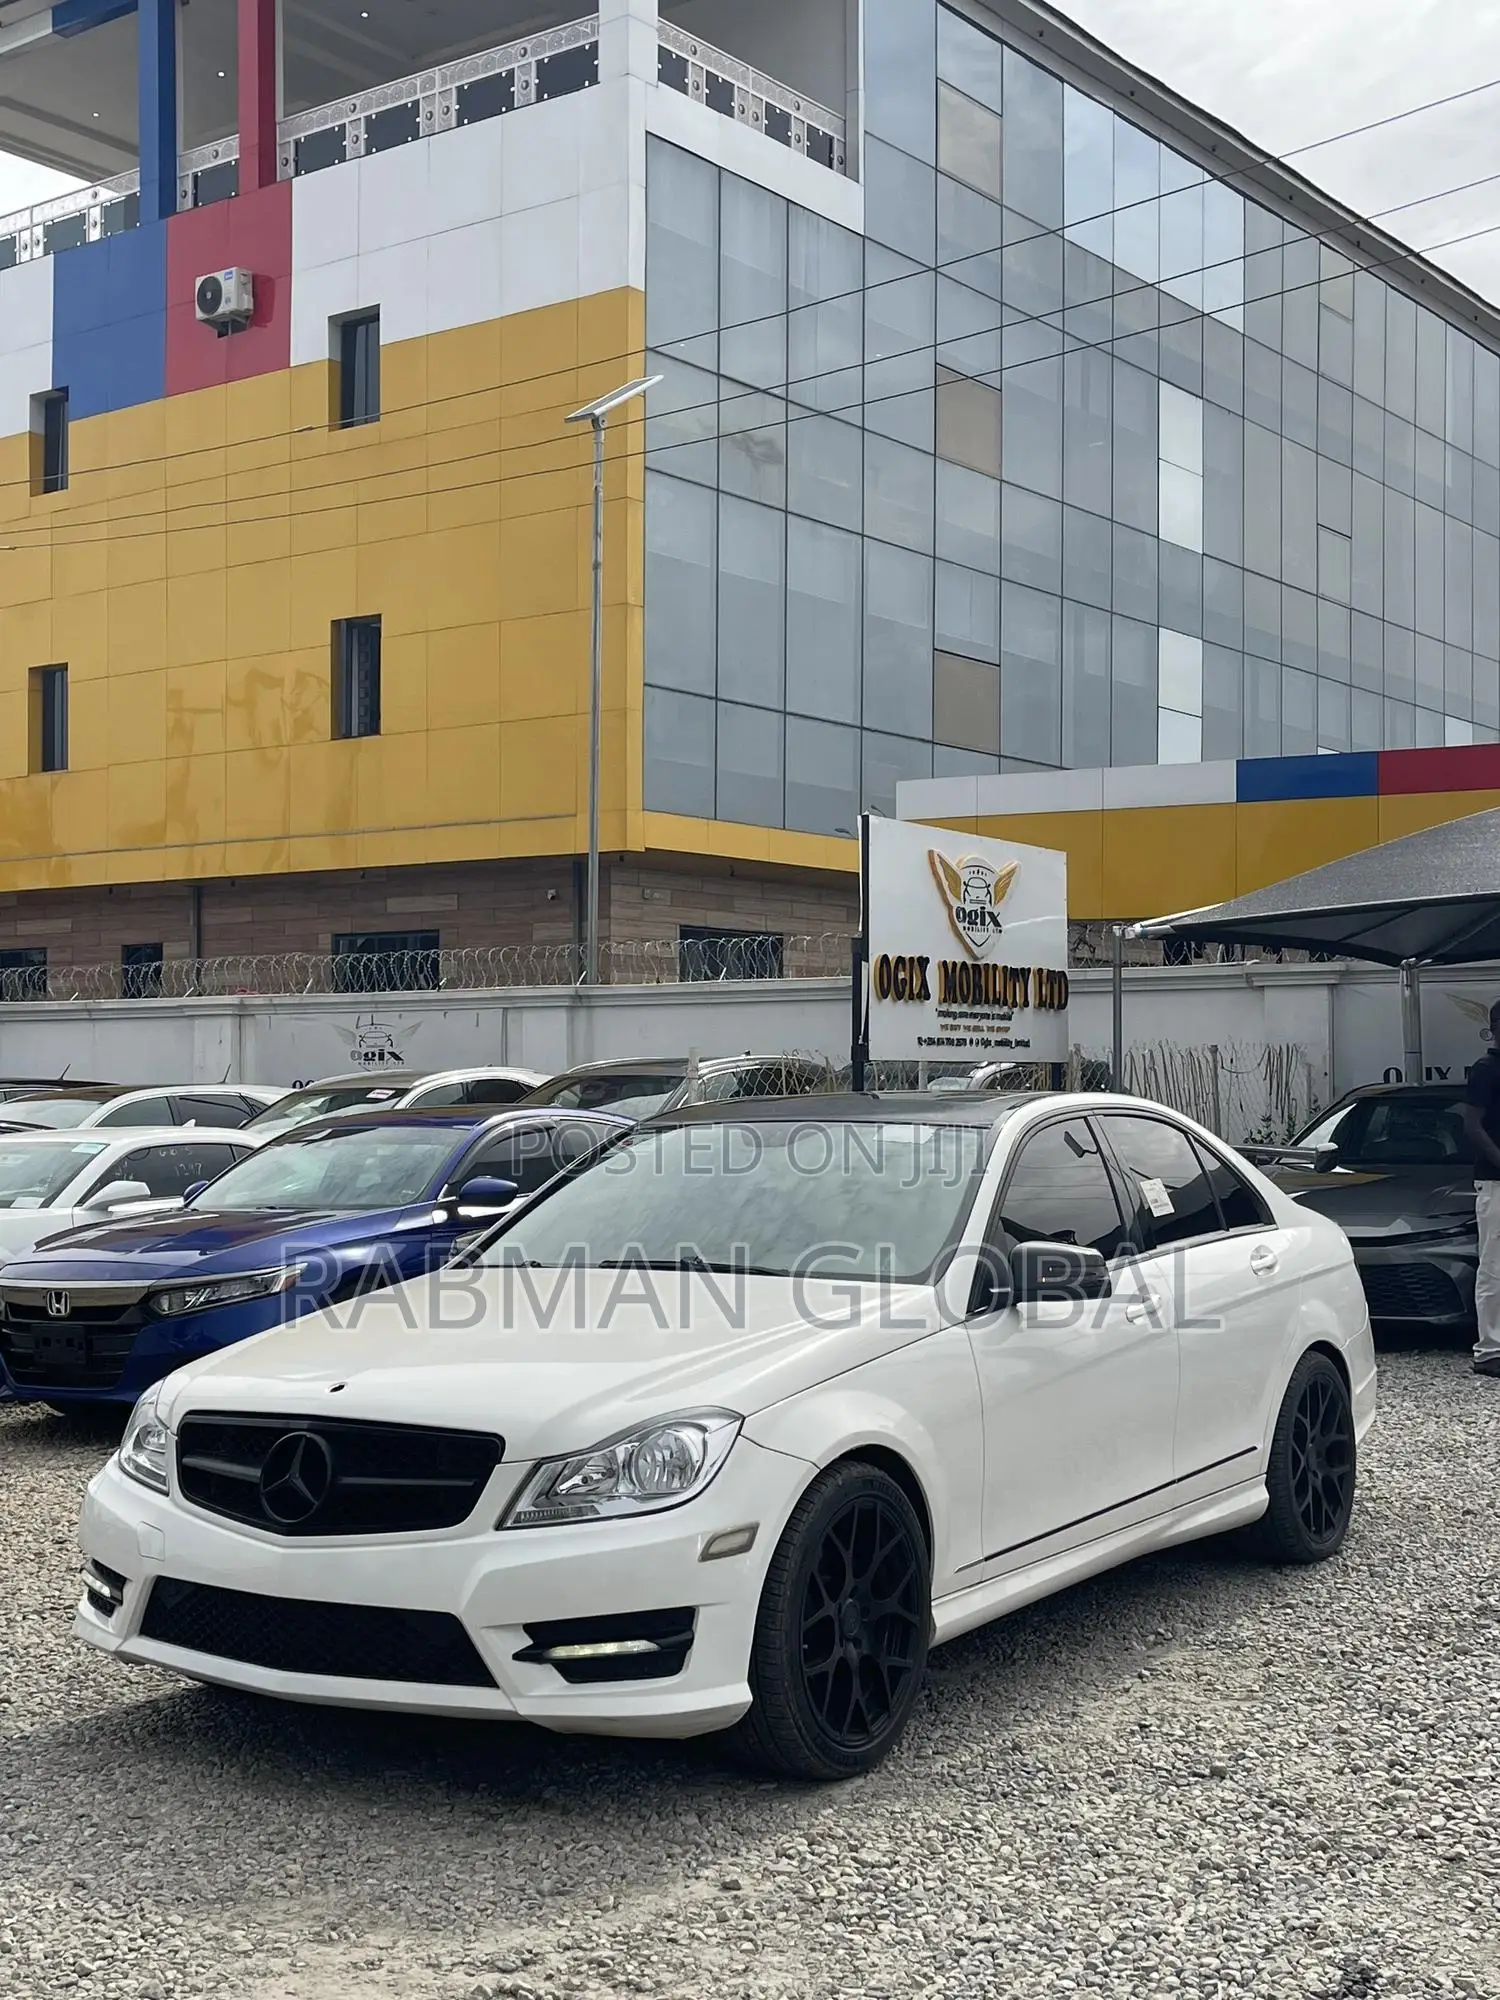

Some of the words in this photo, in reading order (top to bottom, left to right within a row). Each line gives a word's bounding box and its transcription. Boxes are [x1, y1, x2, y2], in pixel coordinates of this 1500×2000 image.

[874, 953, 932, 1001] OGIX
[936, 959, 1032, 1009] MOBILITY
[1032, 967, 1069, 1011] LTD
